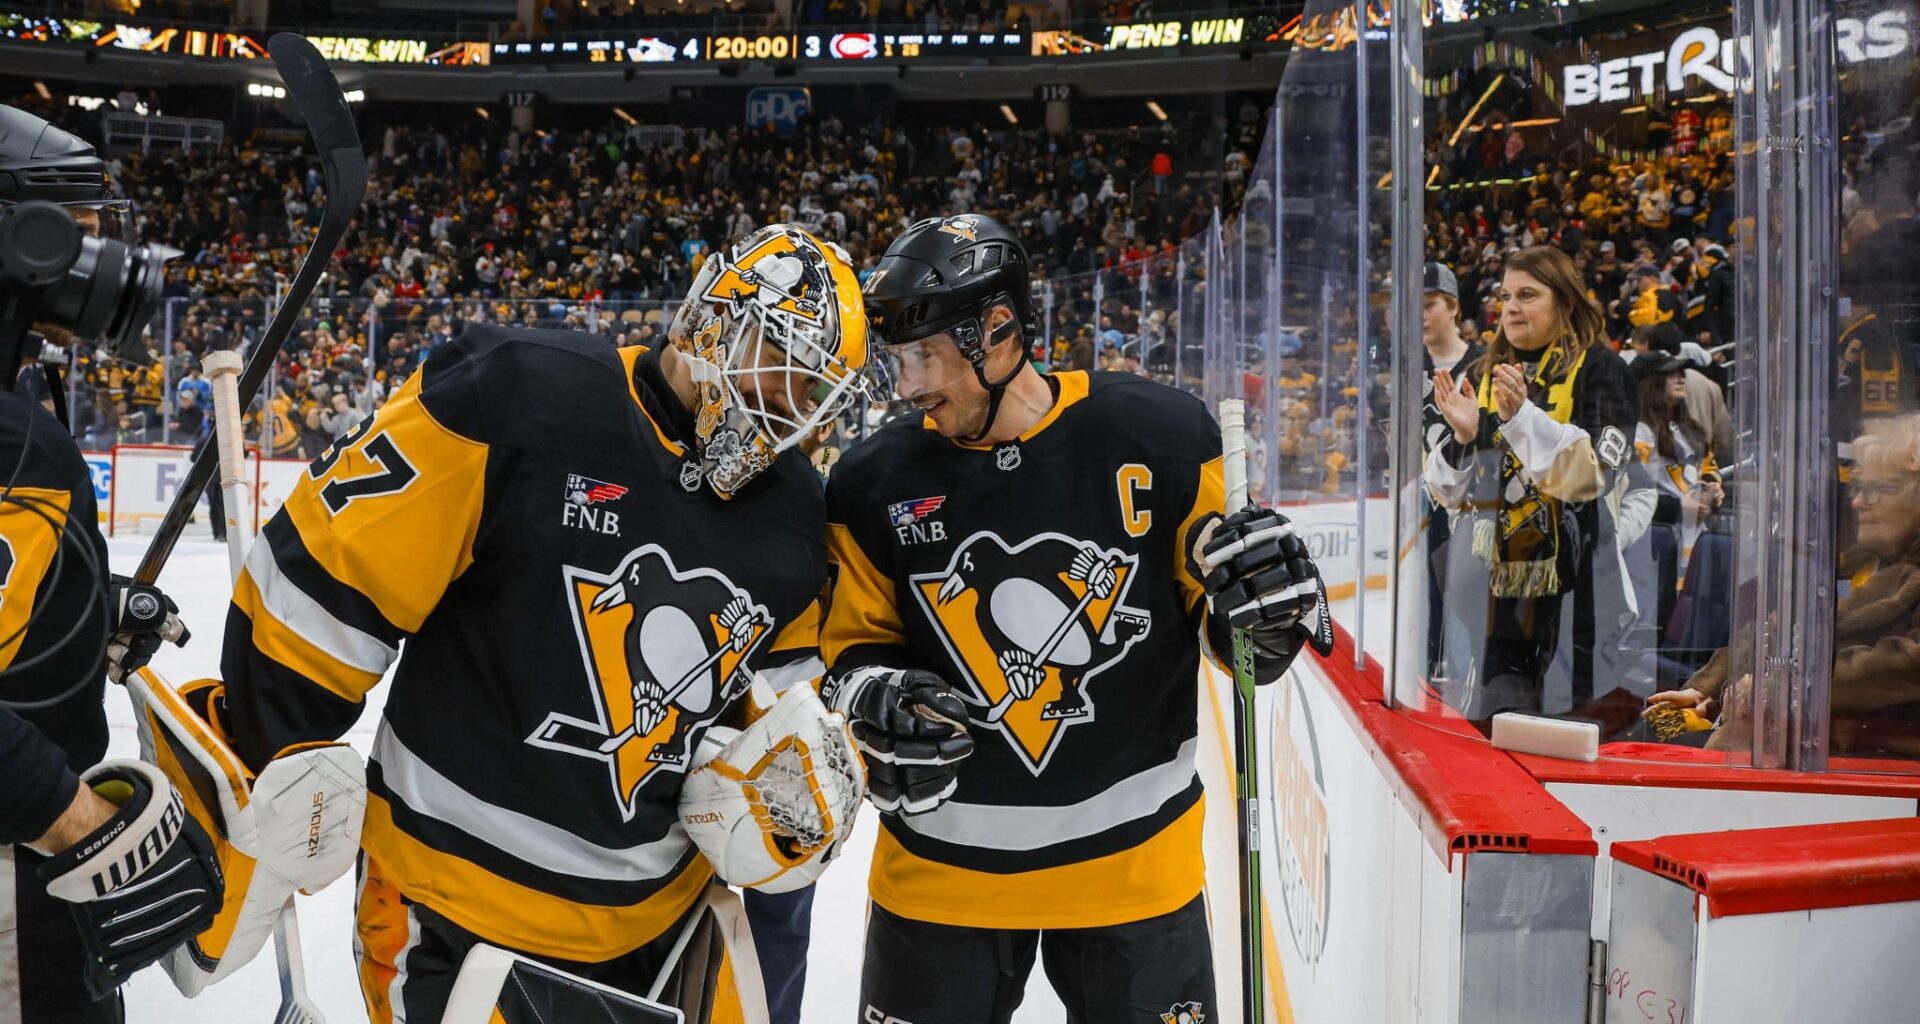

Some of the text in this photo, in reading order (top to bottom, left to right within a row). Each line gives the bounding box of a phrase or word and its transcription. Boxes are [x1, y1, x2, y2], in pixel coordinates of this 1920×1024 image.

[1110, 18, 1244, 48] PENS WIN
[379, 39, 427, 62] WIN
[683, 36, 820, 59] 4 20:00 3
[508, 93, 534, 106] 117
[1041, 85, 1070, 98] 119
[1115, 463, 1153, 538] C
[562, 503, 622, 538] F.N.B.
[895, 521, 948, 546] F.N.B.
[1316, 588, 1332, 645] PENGUINS
[822, 676, 837, 697] 87
[76, 820, 126, 860] LEGEND
